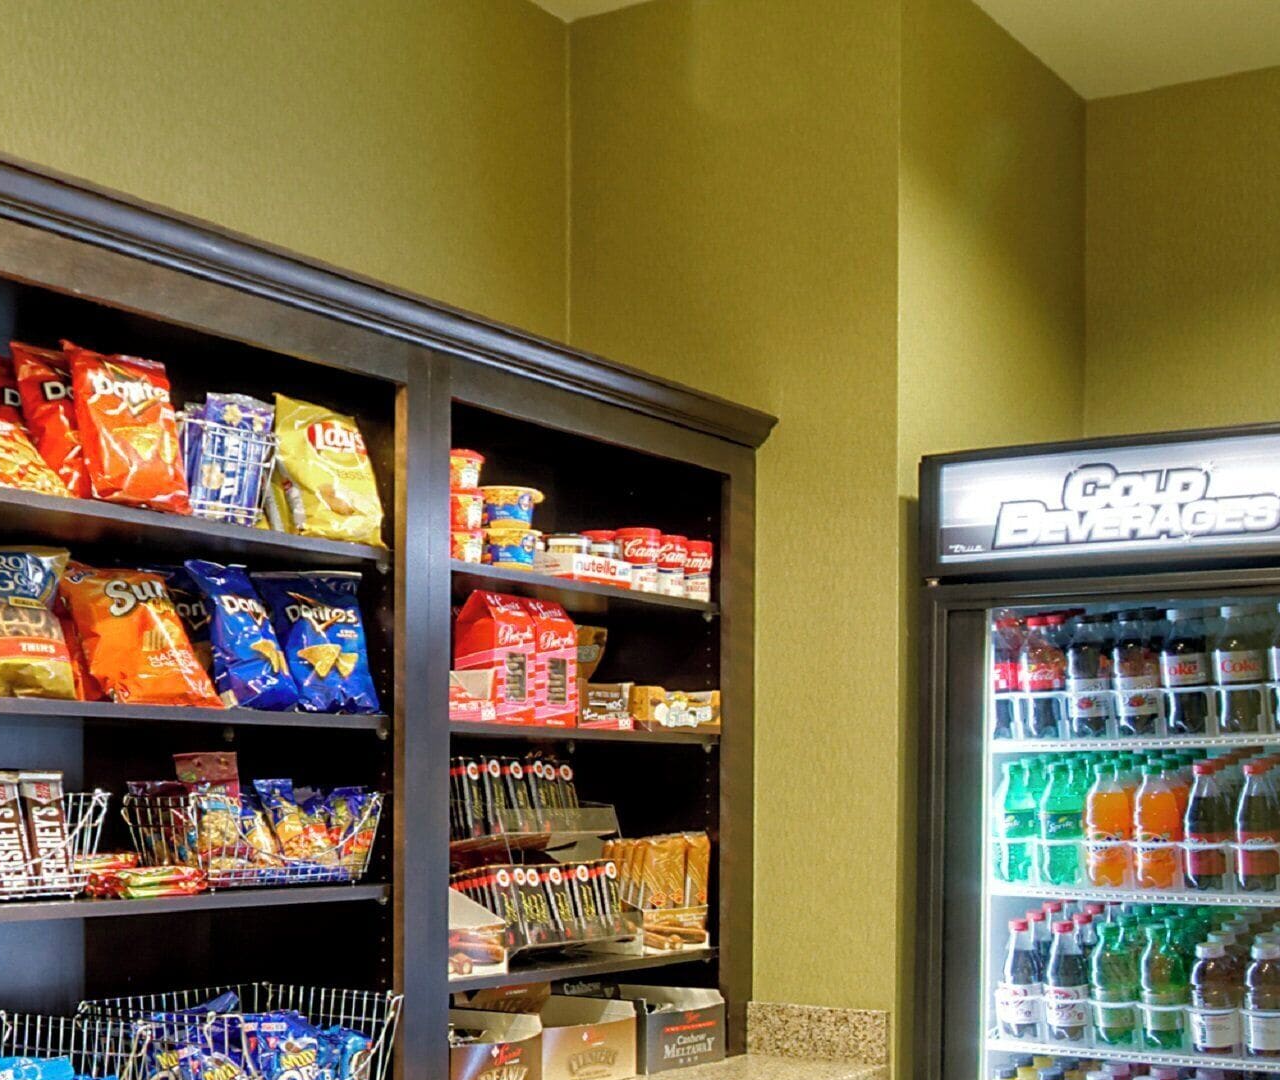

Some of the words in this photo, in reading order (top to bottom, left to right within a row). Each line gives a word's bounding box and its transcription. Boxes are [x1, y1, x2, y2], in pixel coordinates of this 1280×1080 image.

[315, 421, 367, 455] Lay's
[1064, 462, 1211, 510] COLD
[950, 544, 984, 553] true
[575, 557, 618, 577] nutella
[285, 604, 358, 625] Doritos
[1168, 662, 1198, 676] oke
[1221, 657, 1260, 674] Coke
[1047, 820, 1073, 834] Sprite
[563, 981, 601, 995] Cashew
[676, 1033, 707, 1045] Cashew
[663, 1036, 715, 1060] MELTAWAY
